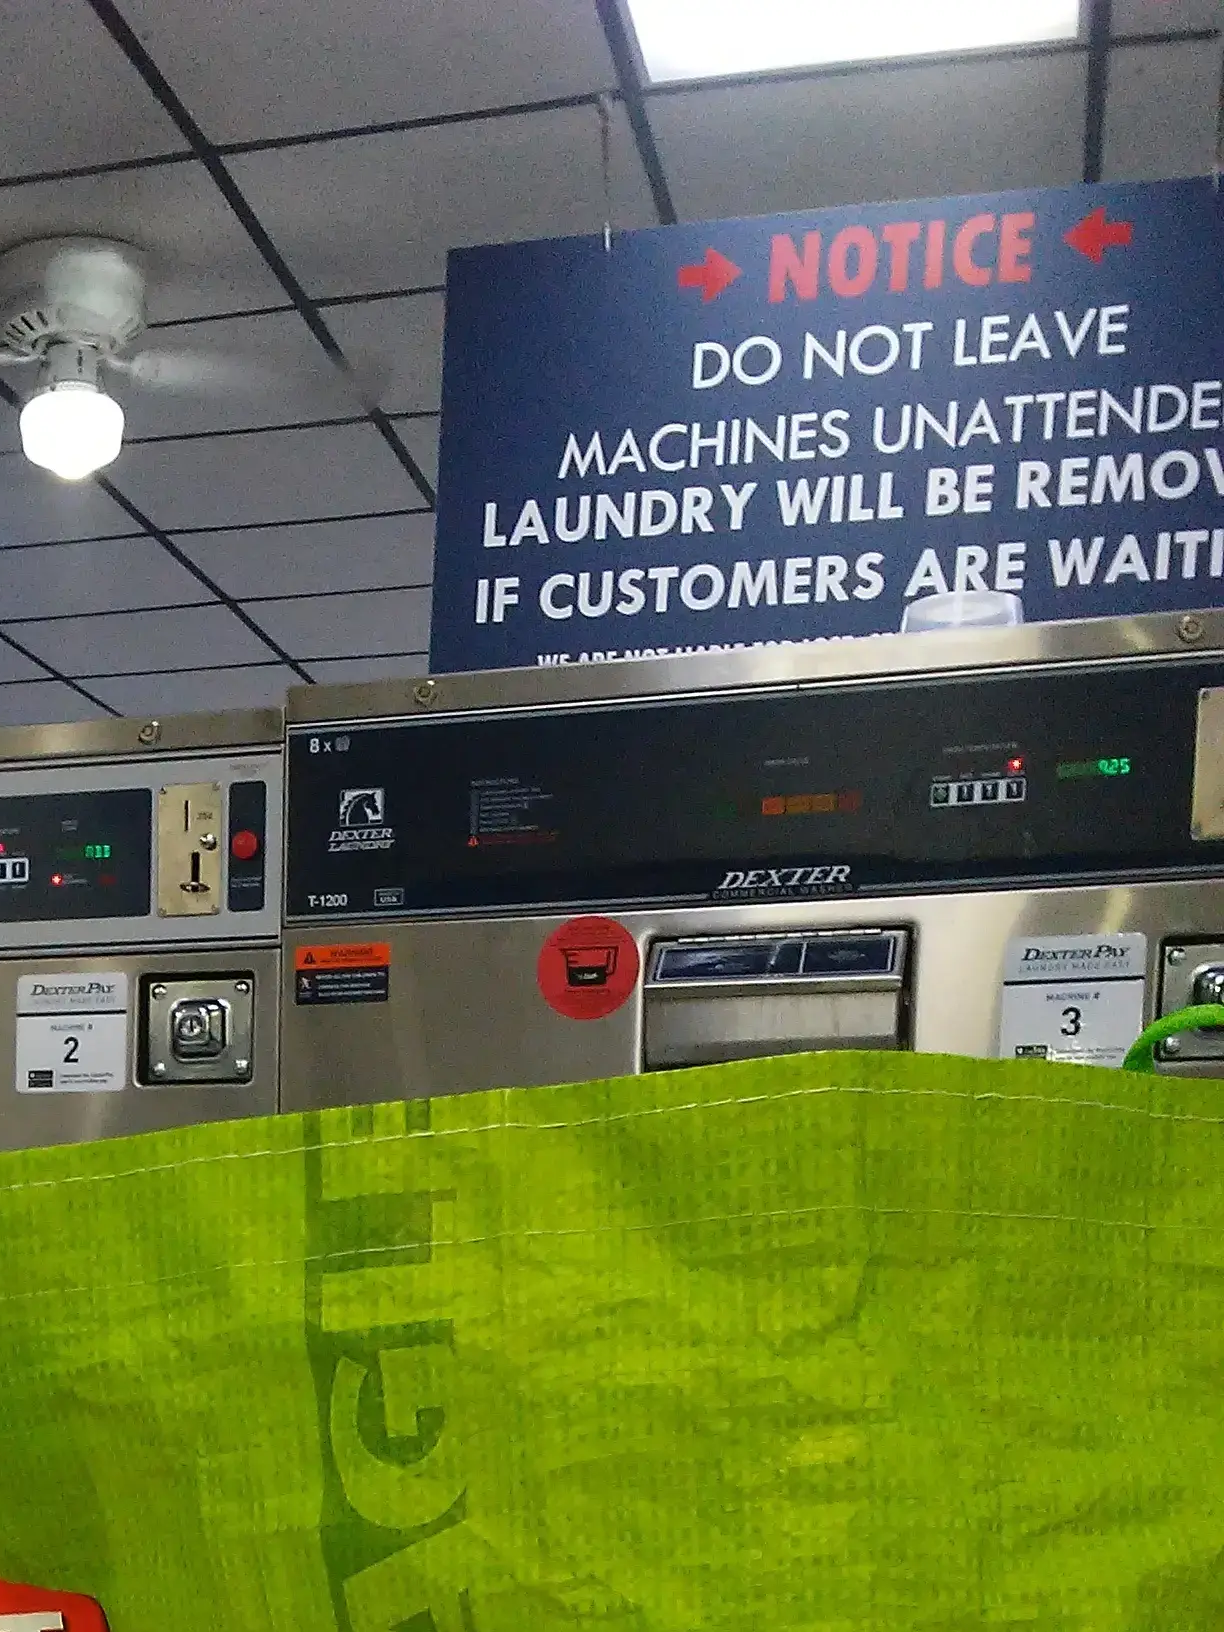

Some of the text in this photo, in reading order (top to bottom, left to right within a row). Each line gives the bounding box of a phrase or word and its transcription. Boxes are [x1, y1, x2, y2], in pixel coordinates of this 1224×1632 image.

[768, 212, 1038, 303] NOTICE
[691, 303, 1131, 389] DO NOT LEAVE
[557, 408, 851, 480] MACHINES
[482, 482, 758, 548] LAUNDRY
[776, 472, 903, 528] WILL
[925, 463, 995, 518] BE
[474, 576, 520, 625] IF
[539, 550, 886, 620] CUSTOMERS
[903, 541, 1026, 598] ARE
[309, 738, 320, 753] 8
[328, 828, 393, 842] DEXTER
[718, 865, 851, 890] DEXTER
[308, 894, 348, 907] T-1200
[1060, 1007, 1081, 1036] 3
[62, 1036, 80, 1064] 2
